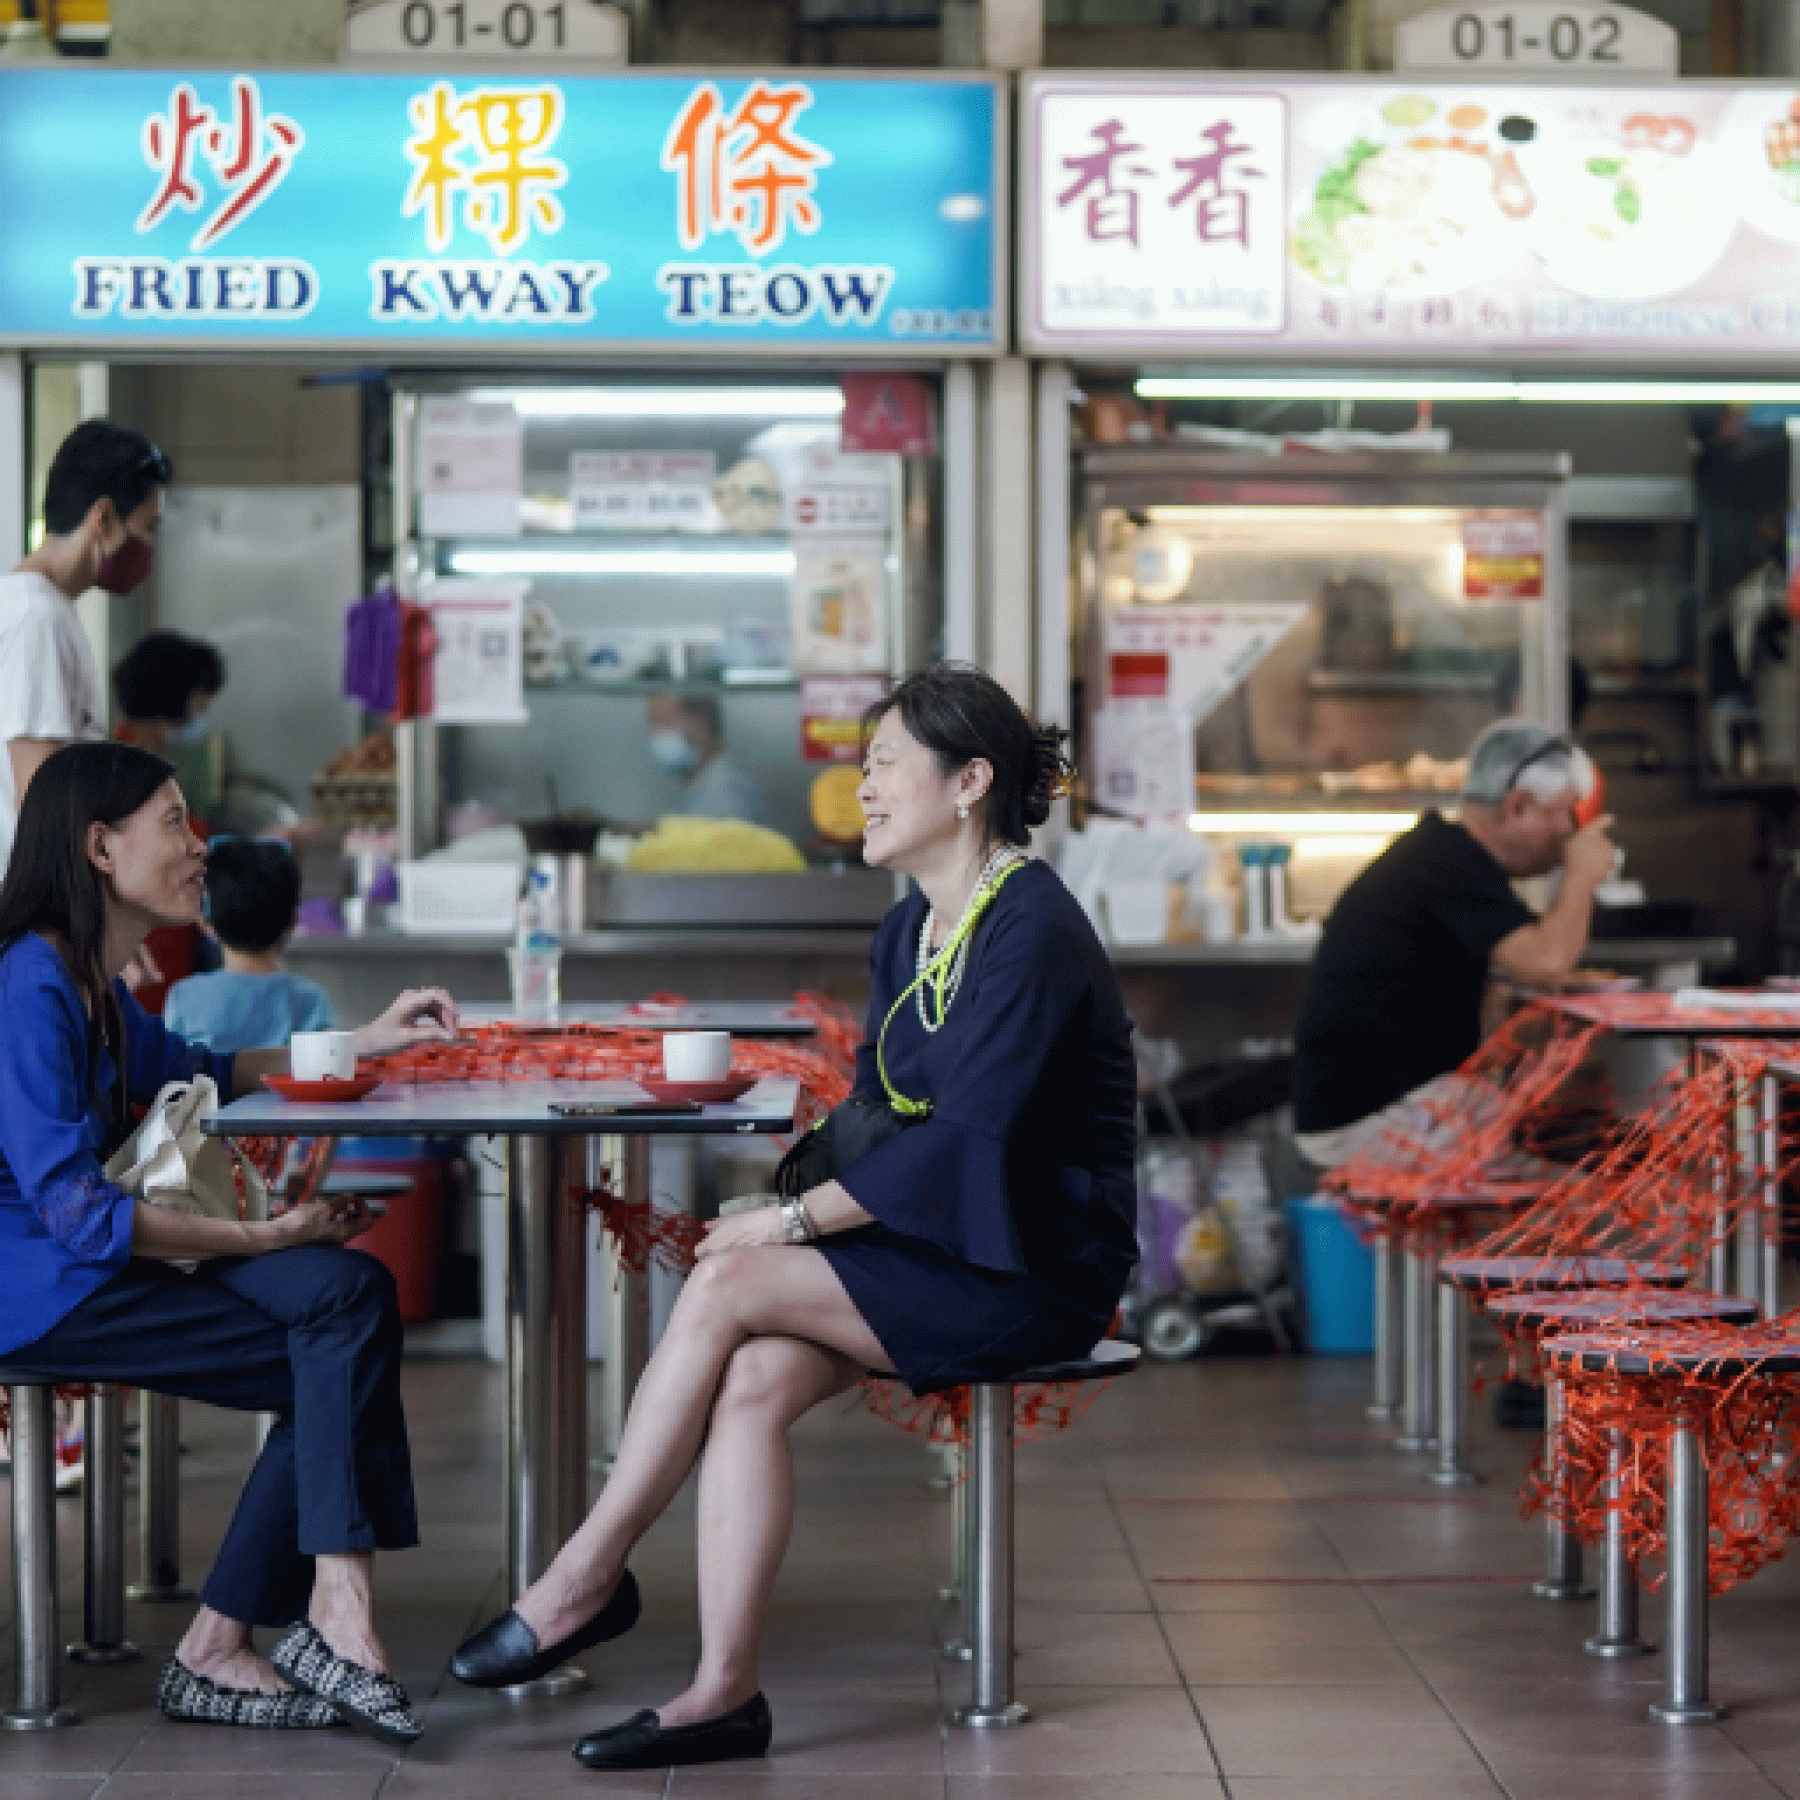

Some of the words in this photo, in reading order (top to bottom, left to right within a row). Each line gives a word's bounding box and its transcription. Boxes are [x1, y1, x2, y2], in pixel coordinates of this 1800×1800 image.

[402, 2, 567, 49] 01-01
[1451, 13, 1623, 62] 01-02
[1056, 118, 1269, 251] 香香
[81, 264, 312, 312] FRIED
[379, 267, 598, 315] KWAY
[665, 271, 887, 318] TEOW
